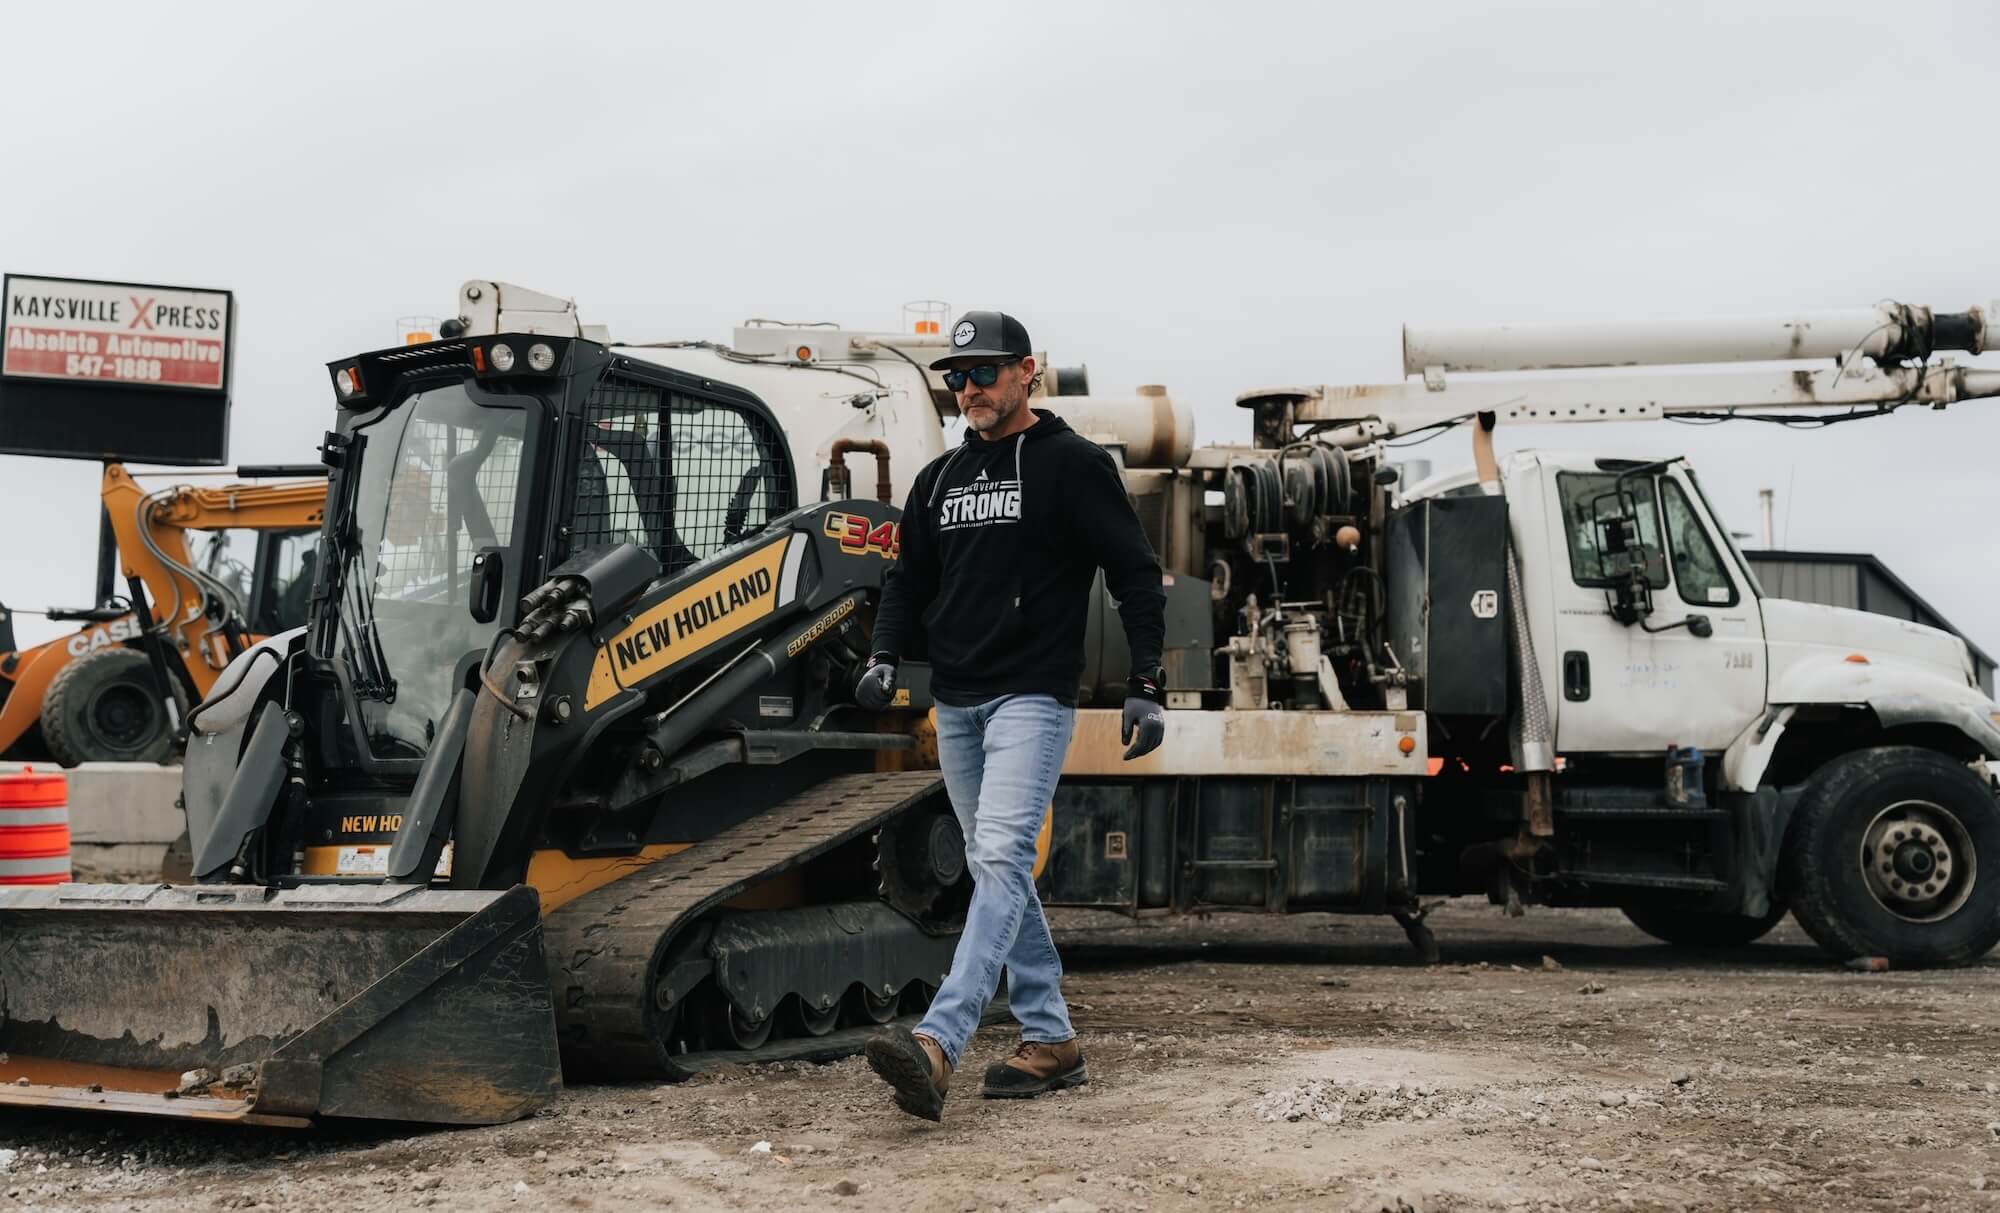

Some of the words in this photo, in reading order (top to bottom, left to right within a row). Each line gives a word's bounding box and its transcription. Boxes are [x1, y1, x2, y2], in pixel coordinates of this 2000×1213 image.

[13, 295, 120, 322] KAYSVILLE
[129, 296, 220, 330] XPRESS
[10, 328, 98, 353] Absolute
[106, 335, 221, 363] Automotive
[940, 490, 1020, 525] STRONG
[824, 511, 900, 560] C34
[616, 618, 671, 671] NEW
[673, 567, 771, 640] HOLLAND
[787, 620, 824, 657] SUPER
[823, 597, 855, 631] BOOM
[342, 815, 377, 832] NEW
